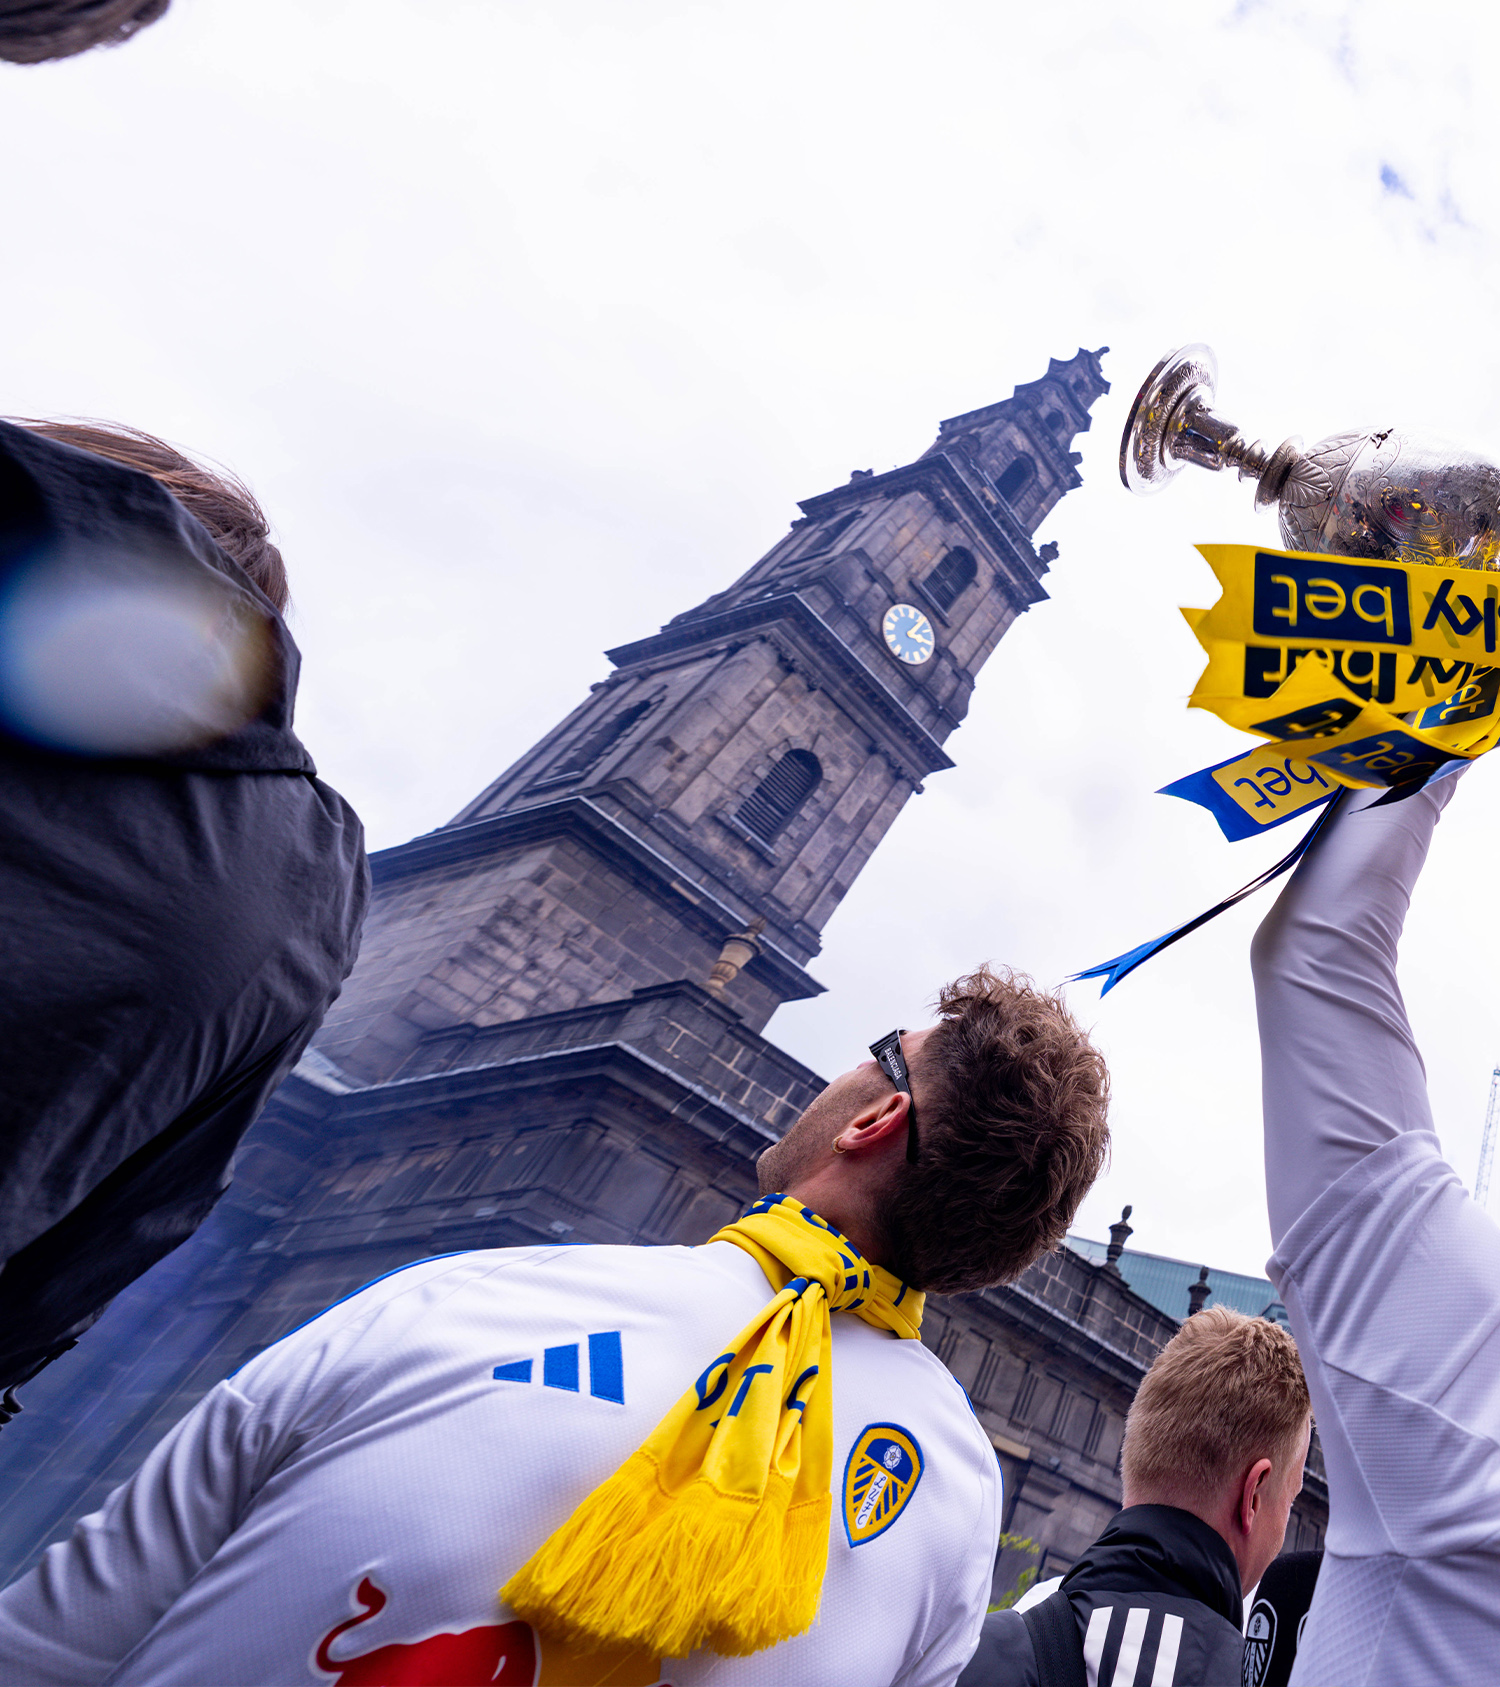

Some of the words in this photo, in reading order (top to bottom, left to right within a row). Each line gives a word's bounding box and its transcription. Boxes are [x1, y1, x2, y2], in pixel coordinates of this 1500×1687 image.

[1271, 574, 1395, 637] bet
[1407, 655, 1496, 690] ky
[1234, 757, 1330, 809] bet
[884, 1047, 903, 1081] BALENCIAGA
[857, 1476, 887, 1526] LUFC
